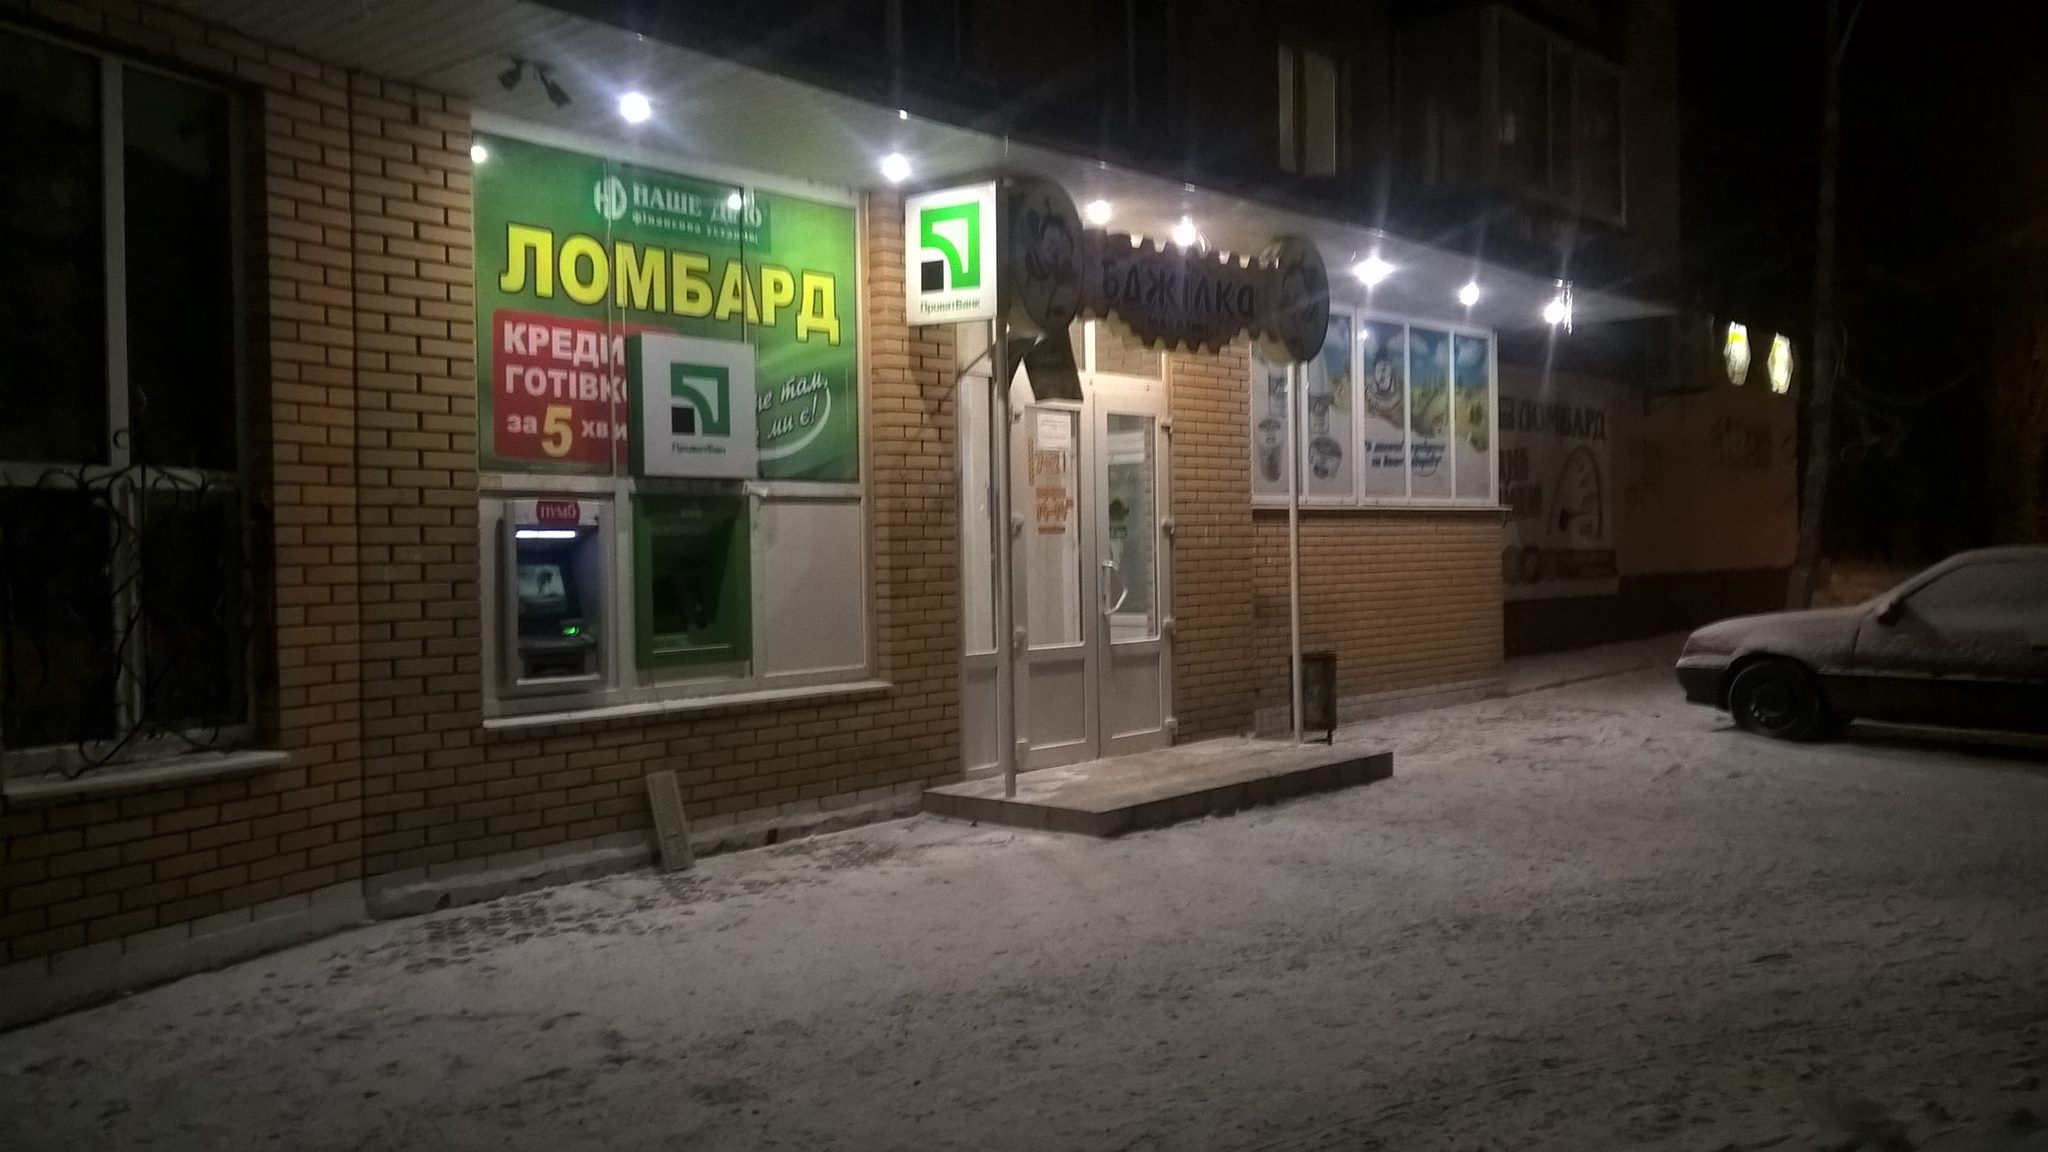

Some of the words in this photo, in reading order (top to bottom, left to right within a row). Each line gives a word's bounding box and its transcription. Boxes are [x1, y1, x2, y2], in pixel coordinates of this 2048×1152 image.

[633, 181, 702, 218] НАШЕ
[499, 222, 841, 345] ЛОМБАРД
[504, 320, 625, 369] КРЕДИ
[505, 363, 628, 404] ГОТІВК
[506, 413, 538, 434] за
[541, 404, 573, 458] 5
[581, 419, 628, 441] хви
